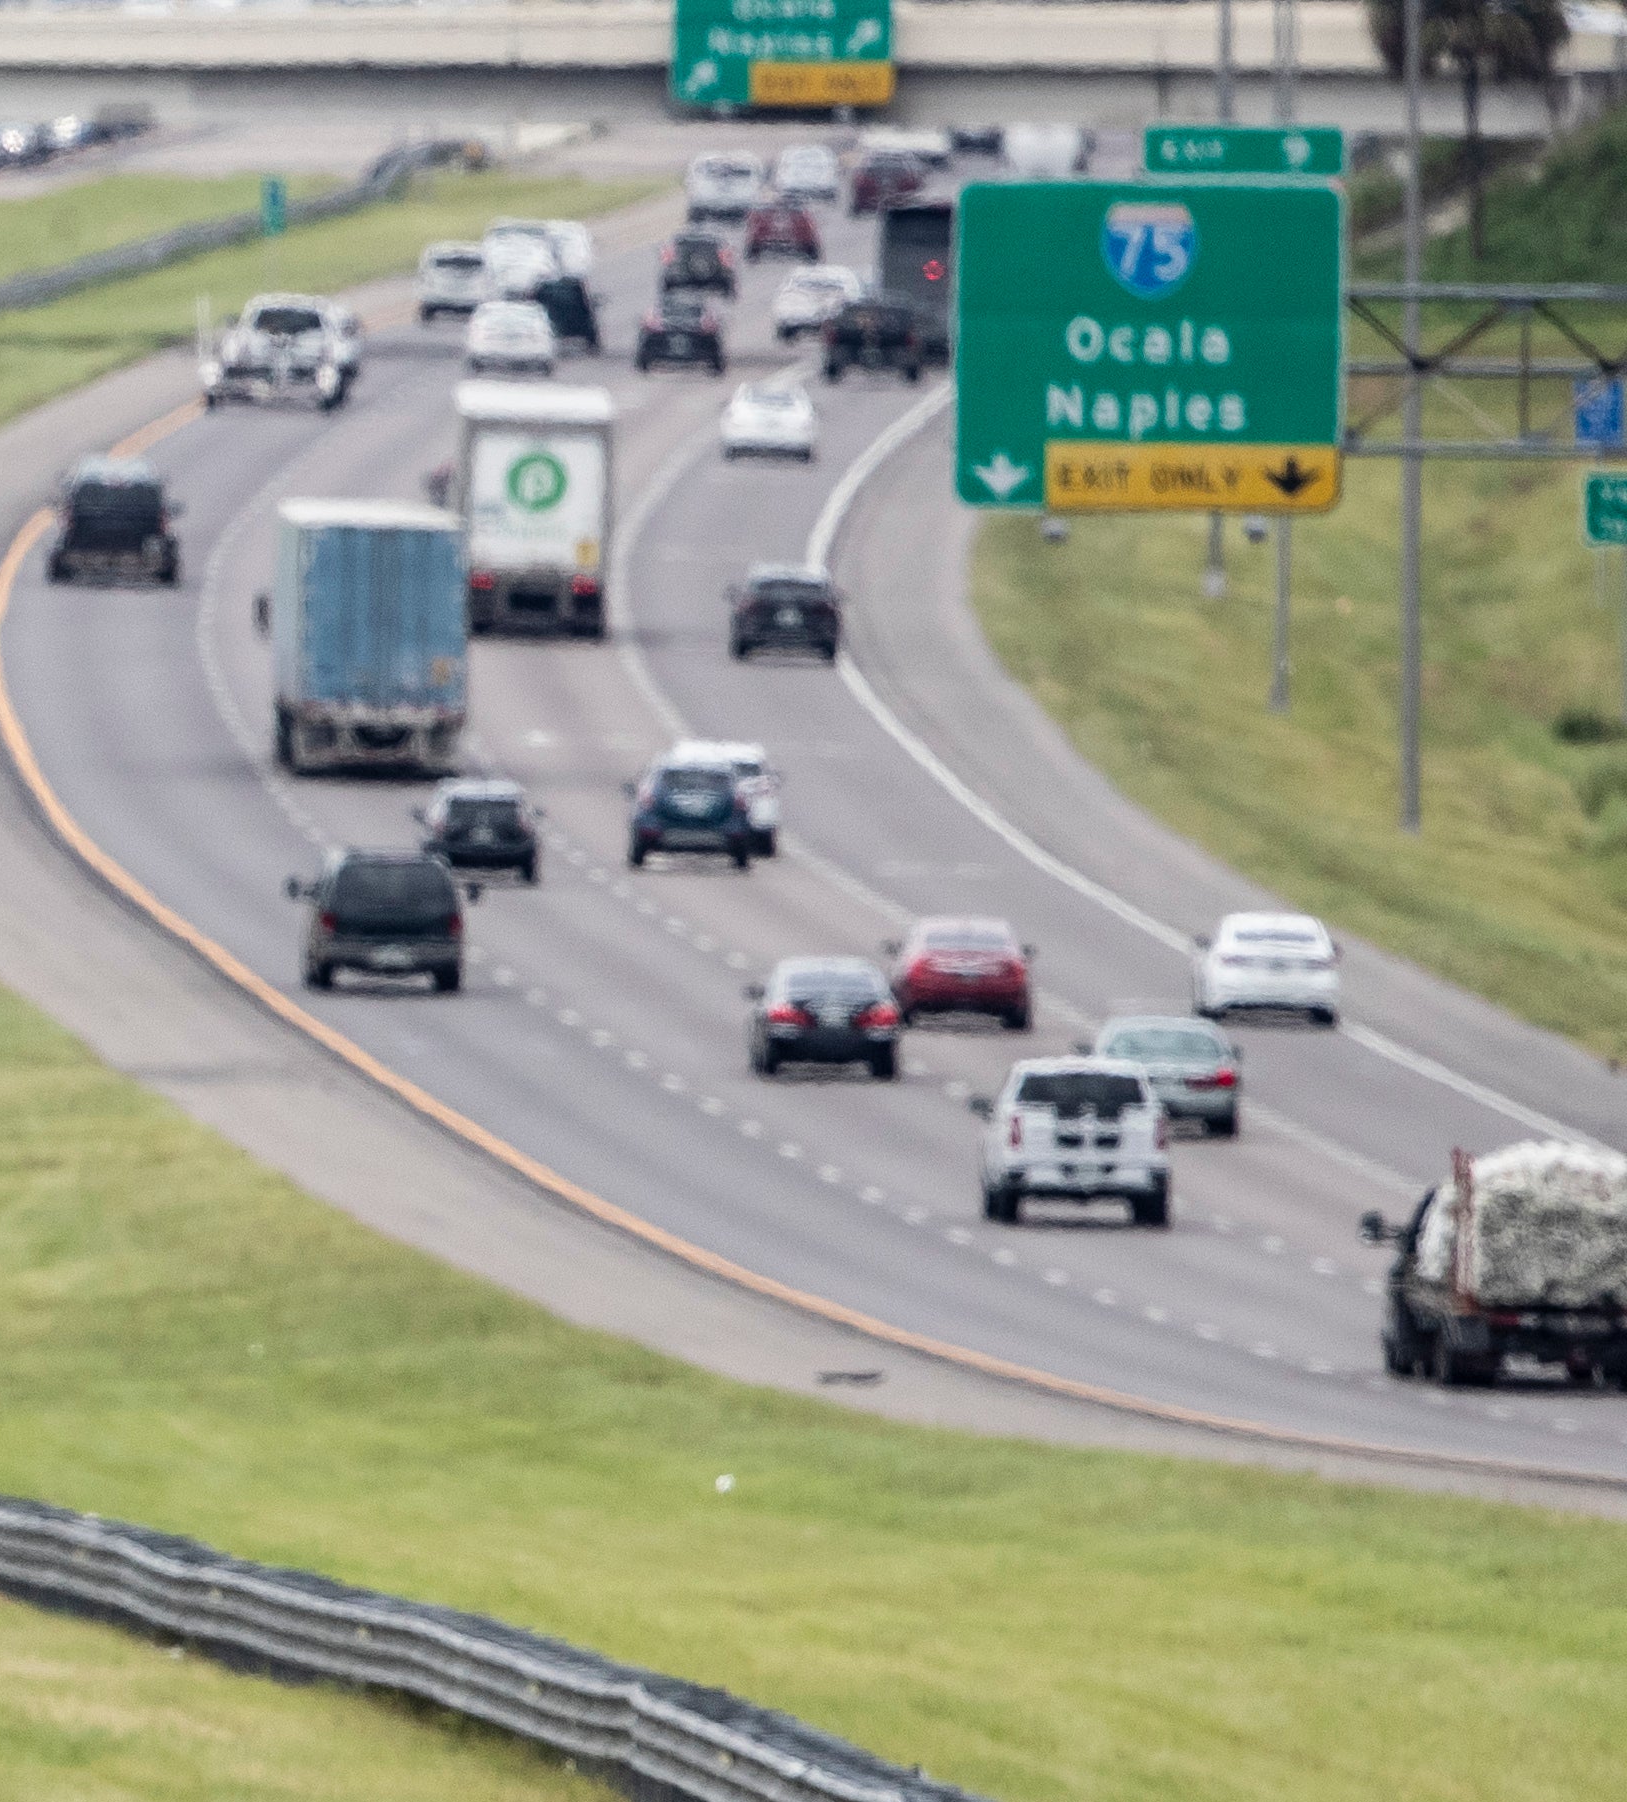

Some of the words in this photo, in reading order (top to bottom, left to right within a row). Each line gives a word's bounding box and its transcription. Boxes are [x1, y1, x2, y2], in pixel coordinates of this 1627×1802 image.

[1110, 225, 1189, 283] 75
[1065, 315, 1231, 364] Ocala
[1048, 382, 1246, 442] Naples
[1057, 460, 1130, 493] EXIT
[1150, 460, 1240, 494] ONLY
